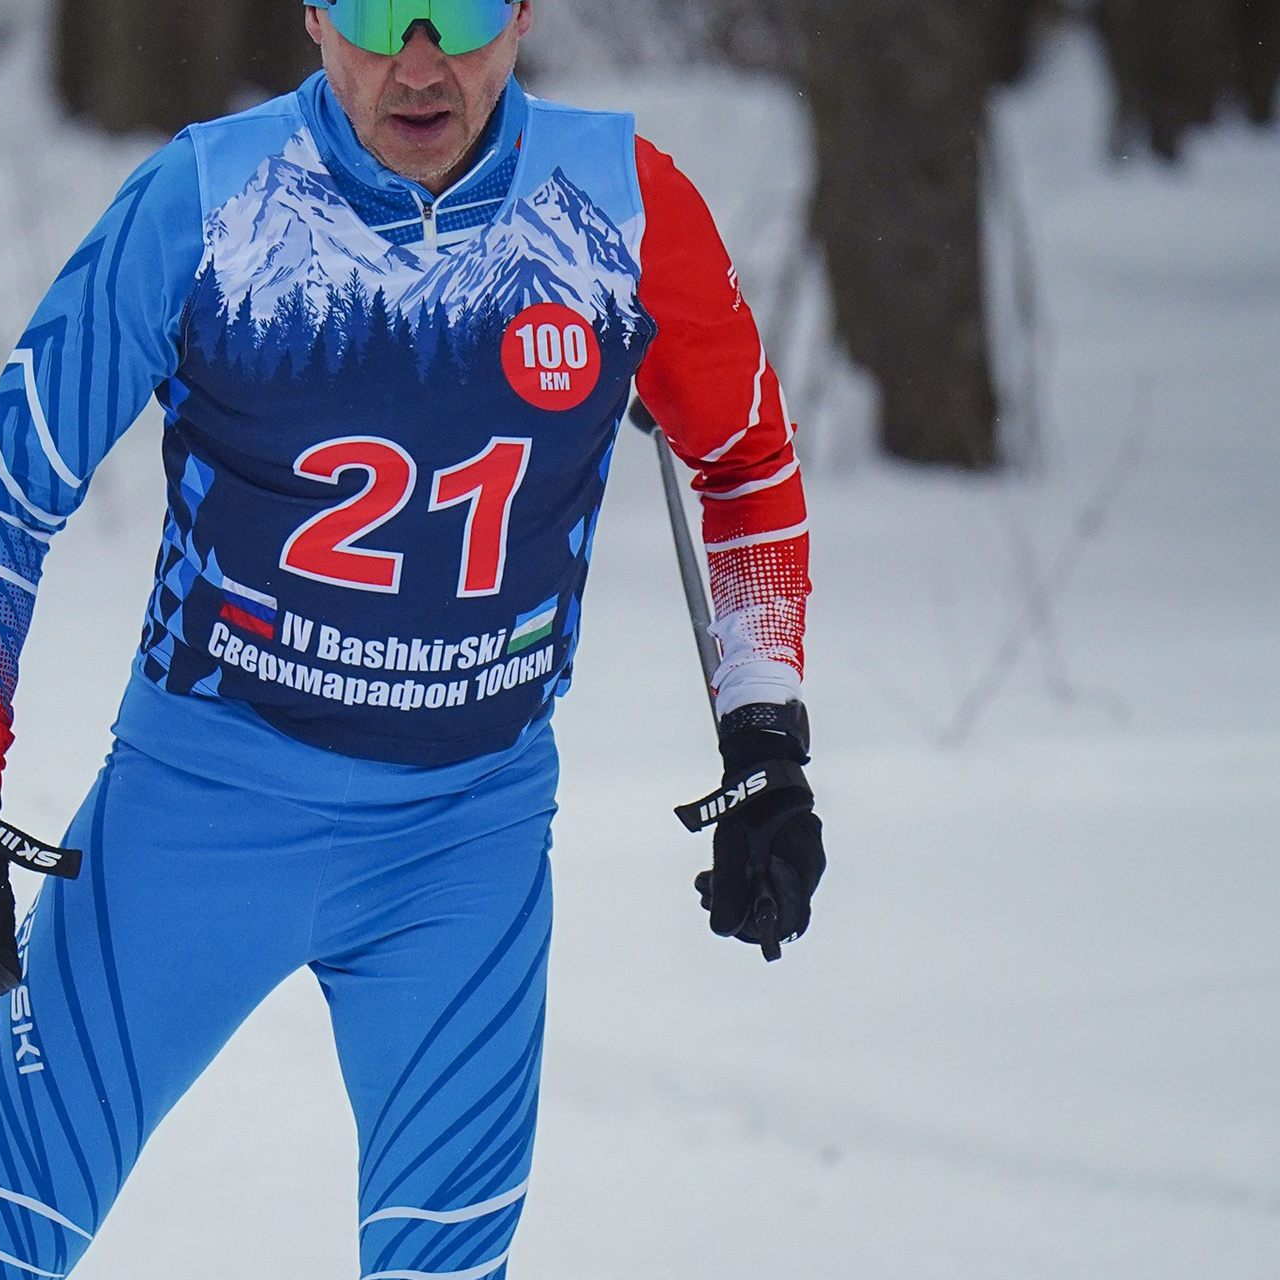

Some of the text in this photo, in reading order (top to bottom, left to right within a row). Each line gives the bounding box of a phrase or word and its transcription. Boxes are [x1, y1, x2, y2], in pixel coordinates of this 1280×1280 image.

[515, 323, 588, 369] 100
[279, 435, 532, 598] 21
[207, 621, 468, 711] Сверхмарафон
[281, 610, 507, 672] IV BashkirSki
